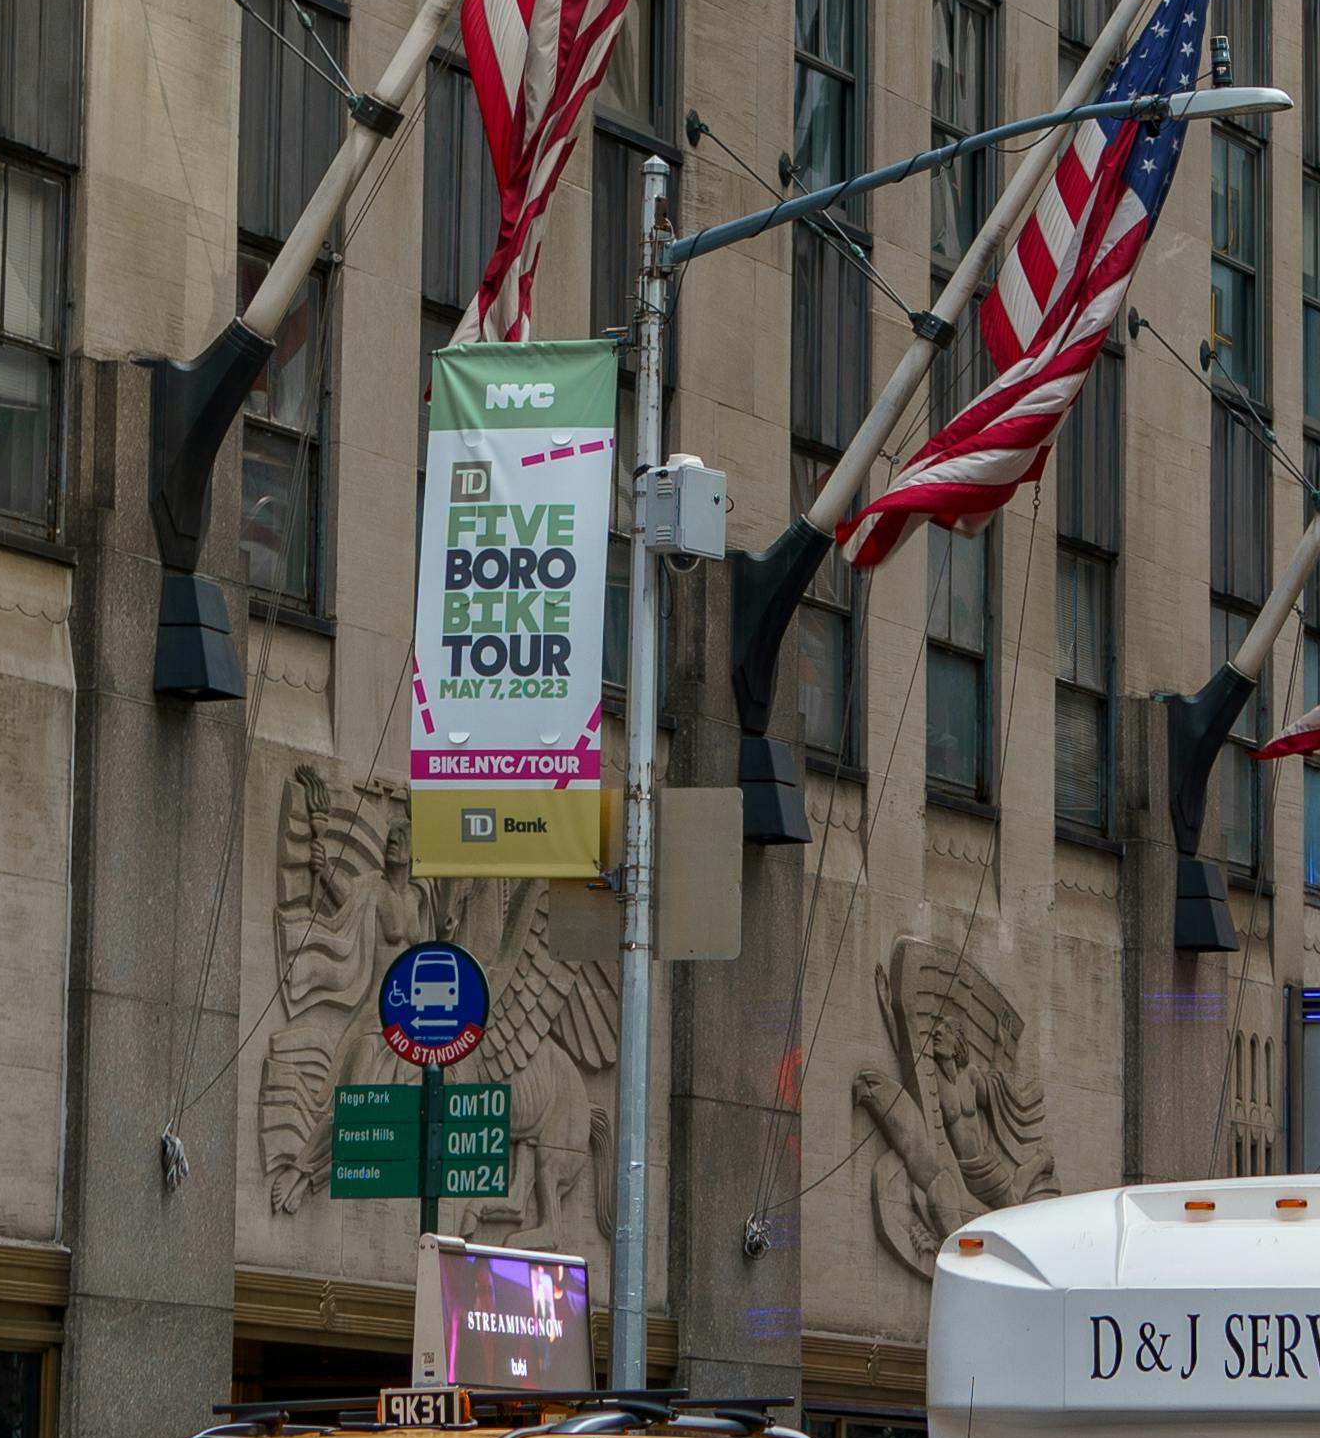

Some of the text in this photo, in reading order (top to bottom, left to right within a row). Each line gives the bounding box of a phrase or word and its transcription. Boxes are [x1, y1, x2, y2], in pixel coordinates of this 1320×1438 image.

[485, 383, 556, 410] NYC
[456, 468, 488, 496] TD
[447, 504, 575, 547] FIVE
[444, 547, 577, 590] BORO
[442, 590, 571, 634] BIKE
[442, 634, 572, 677] TOUR
[439, 677, 569, 701] MAY 7, 2023
[428, 755, 580, 775] BIKE.NYC/TOUR
[464, 813, 548, 837] TD Bank
[390, 1030, 476, 1064] NO STANDING
[339, 1091, 390, 1105] Rego Park
[449, 1089, 506, 1118] QM10
[338, 1128, 395, 1142] Forest Hills
[447, 1127, 505, 1156] QM12
[336, 1166, 380, 1180] Glendale
[446, 1165, 505, 1193] QM24
[467, 1310, 564, 1338] STREAMING NOW
[1090, 1315, 1123, 1380] D
[1135, 1322, 1173, 1373] &
[1180, 1314, 1201, 1380] J
[390, 1394, 446, 1425] 9K31
